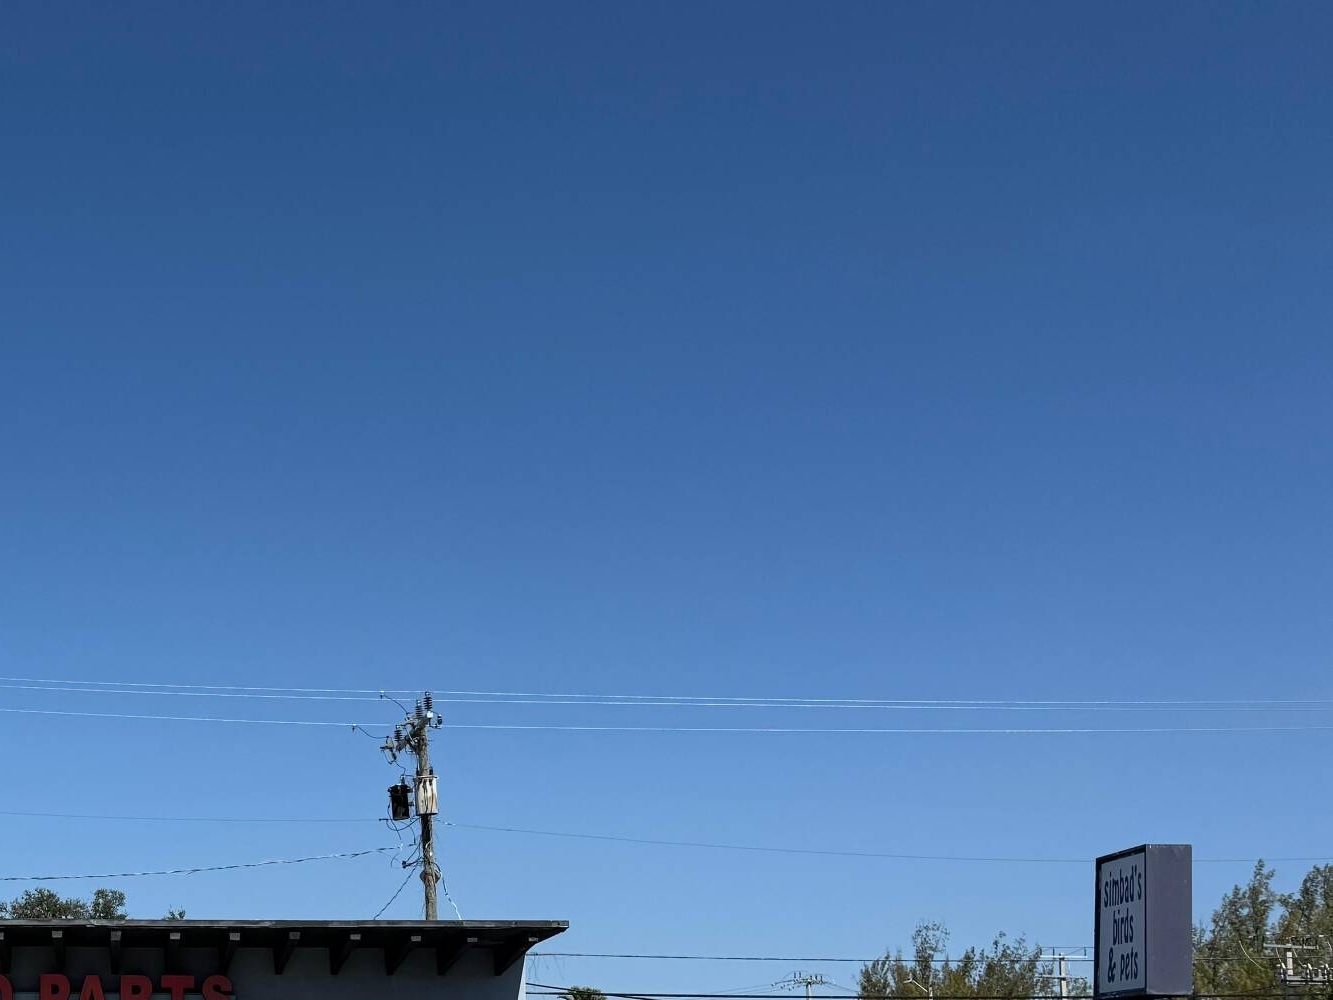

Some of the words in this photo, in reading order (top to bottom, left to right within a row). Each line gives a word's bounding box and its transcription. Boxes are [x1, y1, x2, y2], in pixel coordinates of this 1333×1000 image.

[1103, 864, 1142, 908] simbad's
[1112, 908, 1134, 946] birds
[1107, 947, 1116, 984] &
[1119, 947, 1139, 981] pets
